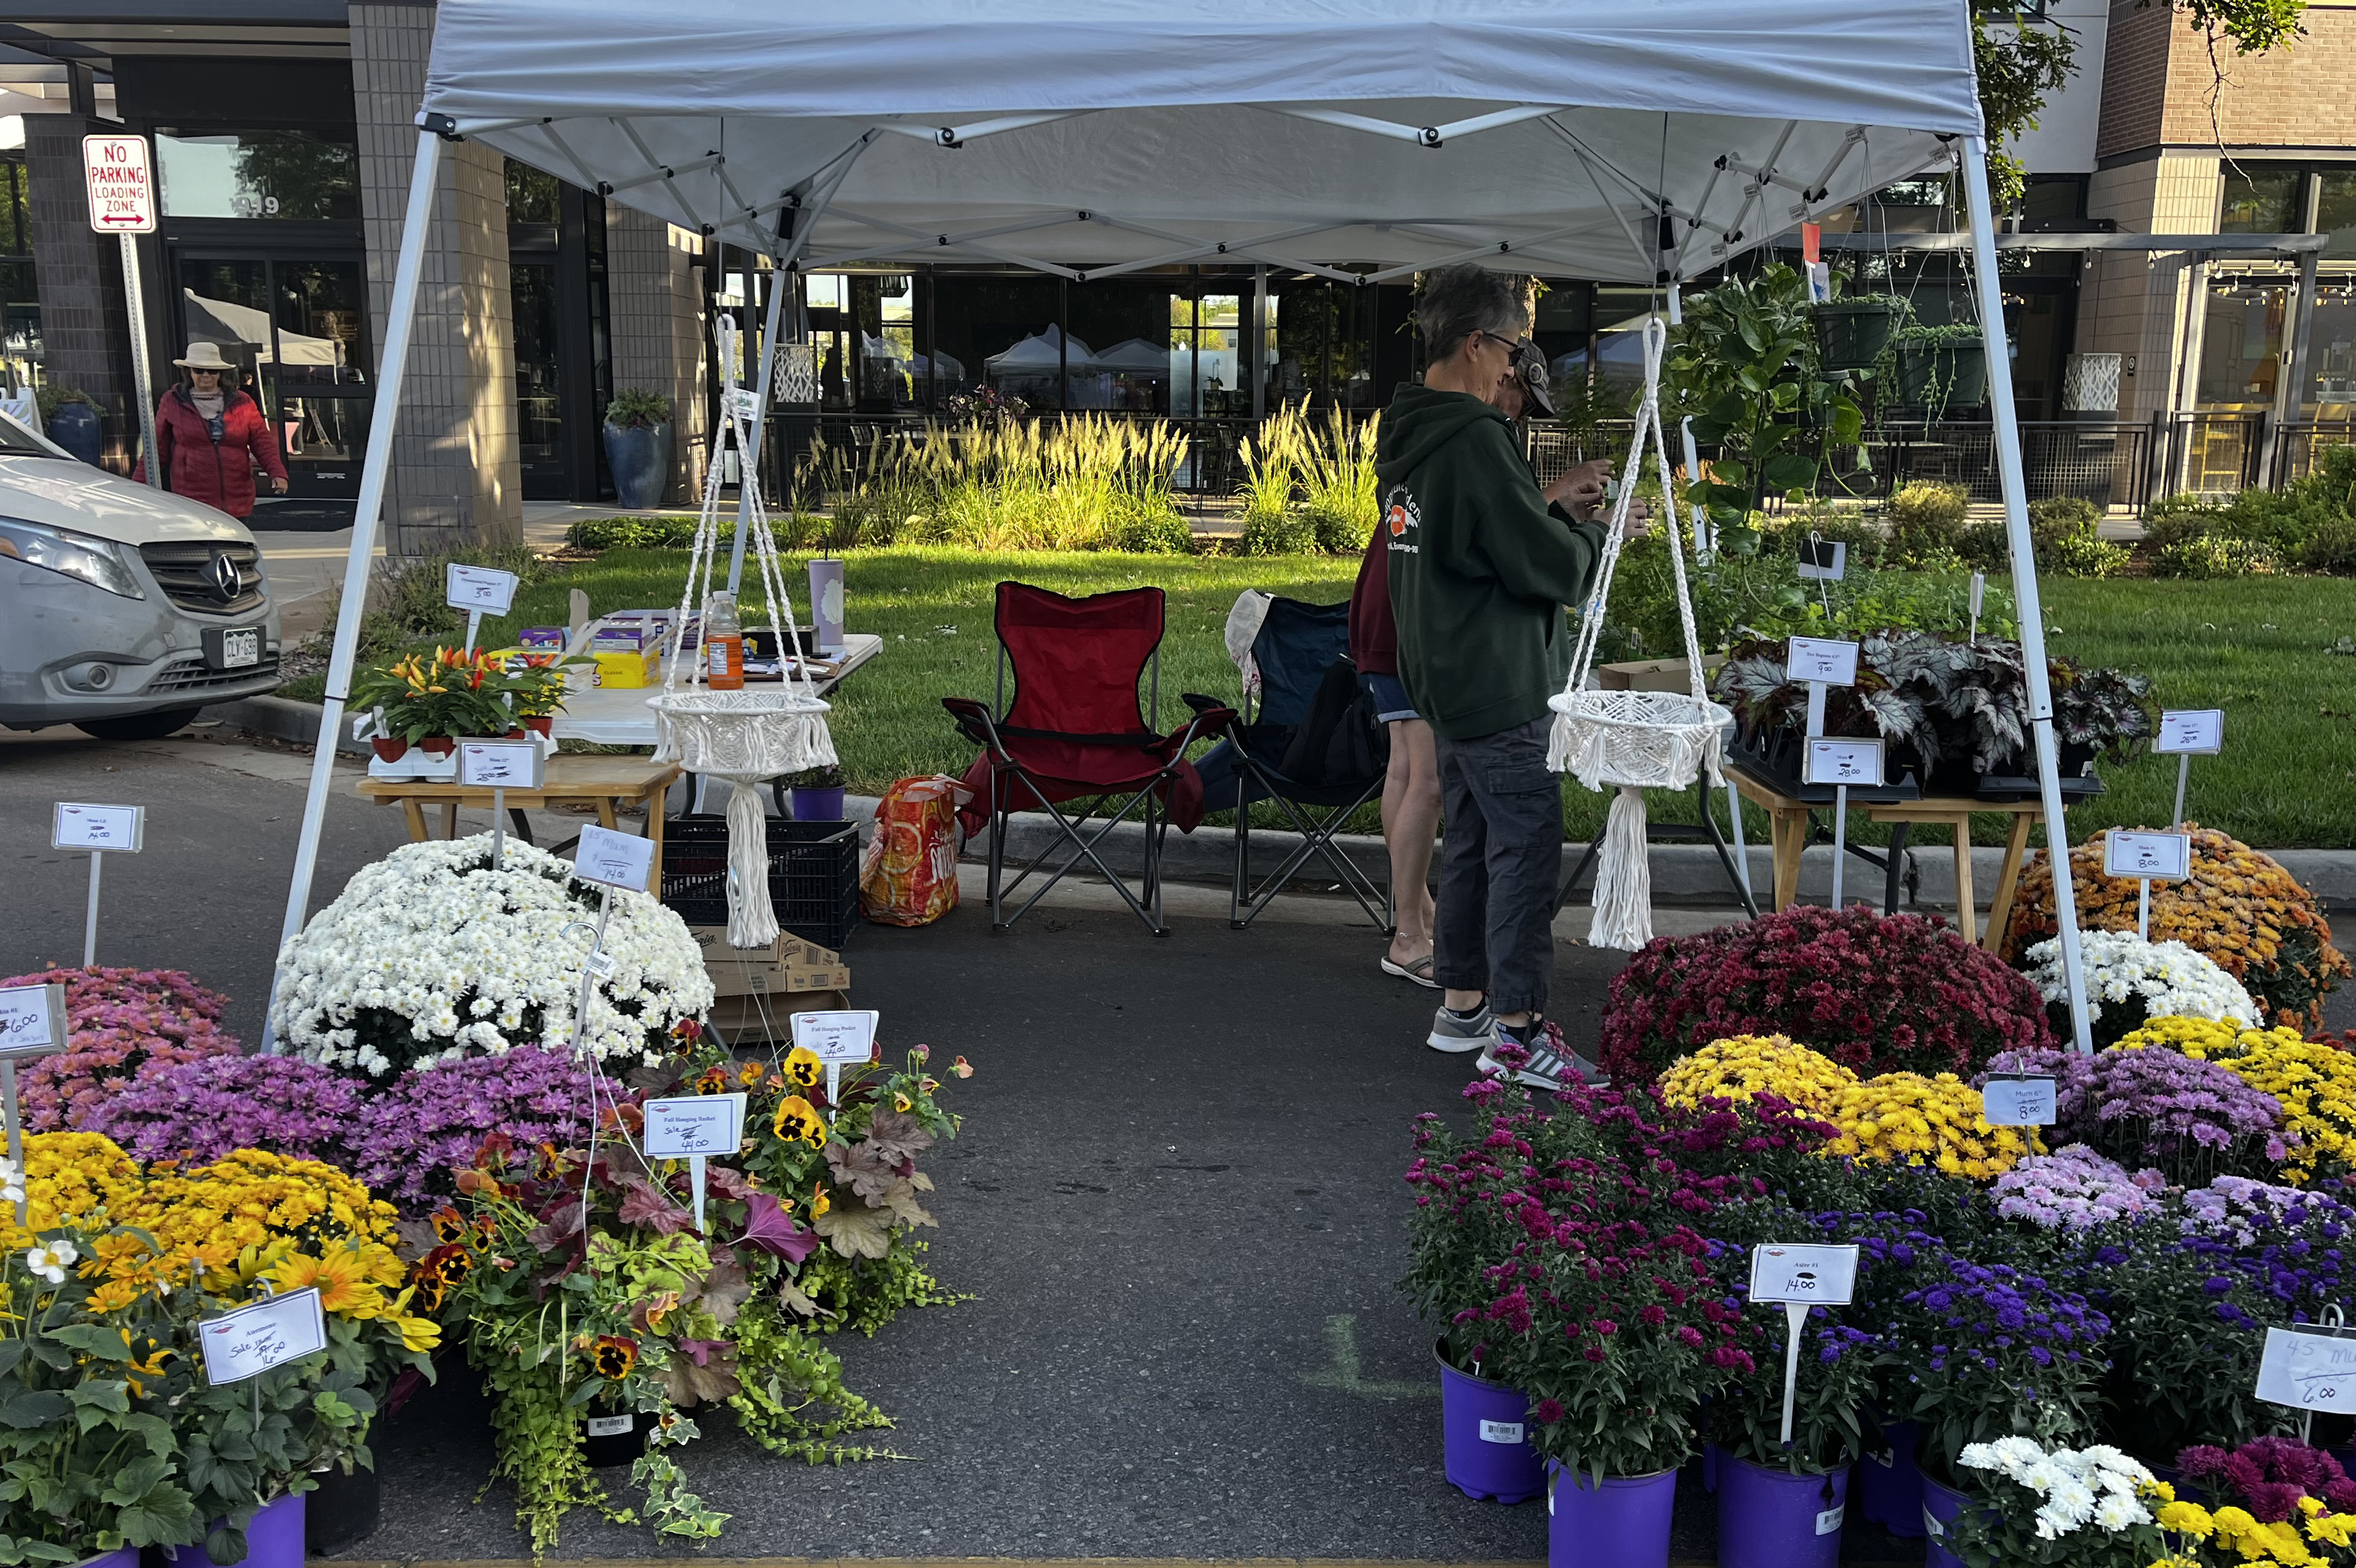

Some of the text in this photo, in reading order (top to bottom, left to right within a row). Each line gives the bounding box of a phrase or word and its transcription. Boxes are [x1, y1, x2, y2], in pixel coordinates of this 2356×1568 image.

[105, 145, 127, 163] NO
[92, 167, 144, 183] PARKING
[95, 187, 144, 198] LOADING
[107, 200, 136, 212] ZONE
[236, 196, 279, 214] 919
[11, 1014, 38, 1033] 6.00
[681, 1140, 710, 1153] 44.00
[1785, 1279, 1816, 1292] 14.00
[246, 1322, 277, 1337] Anemone
[229, 1343, 252, 1358] Sale
[2302, 1387, 2336, 1404] 6.00
